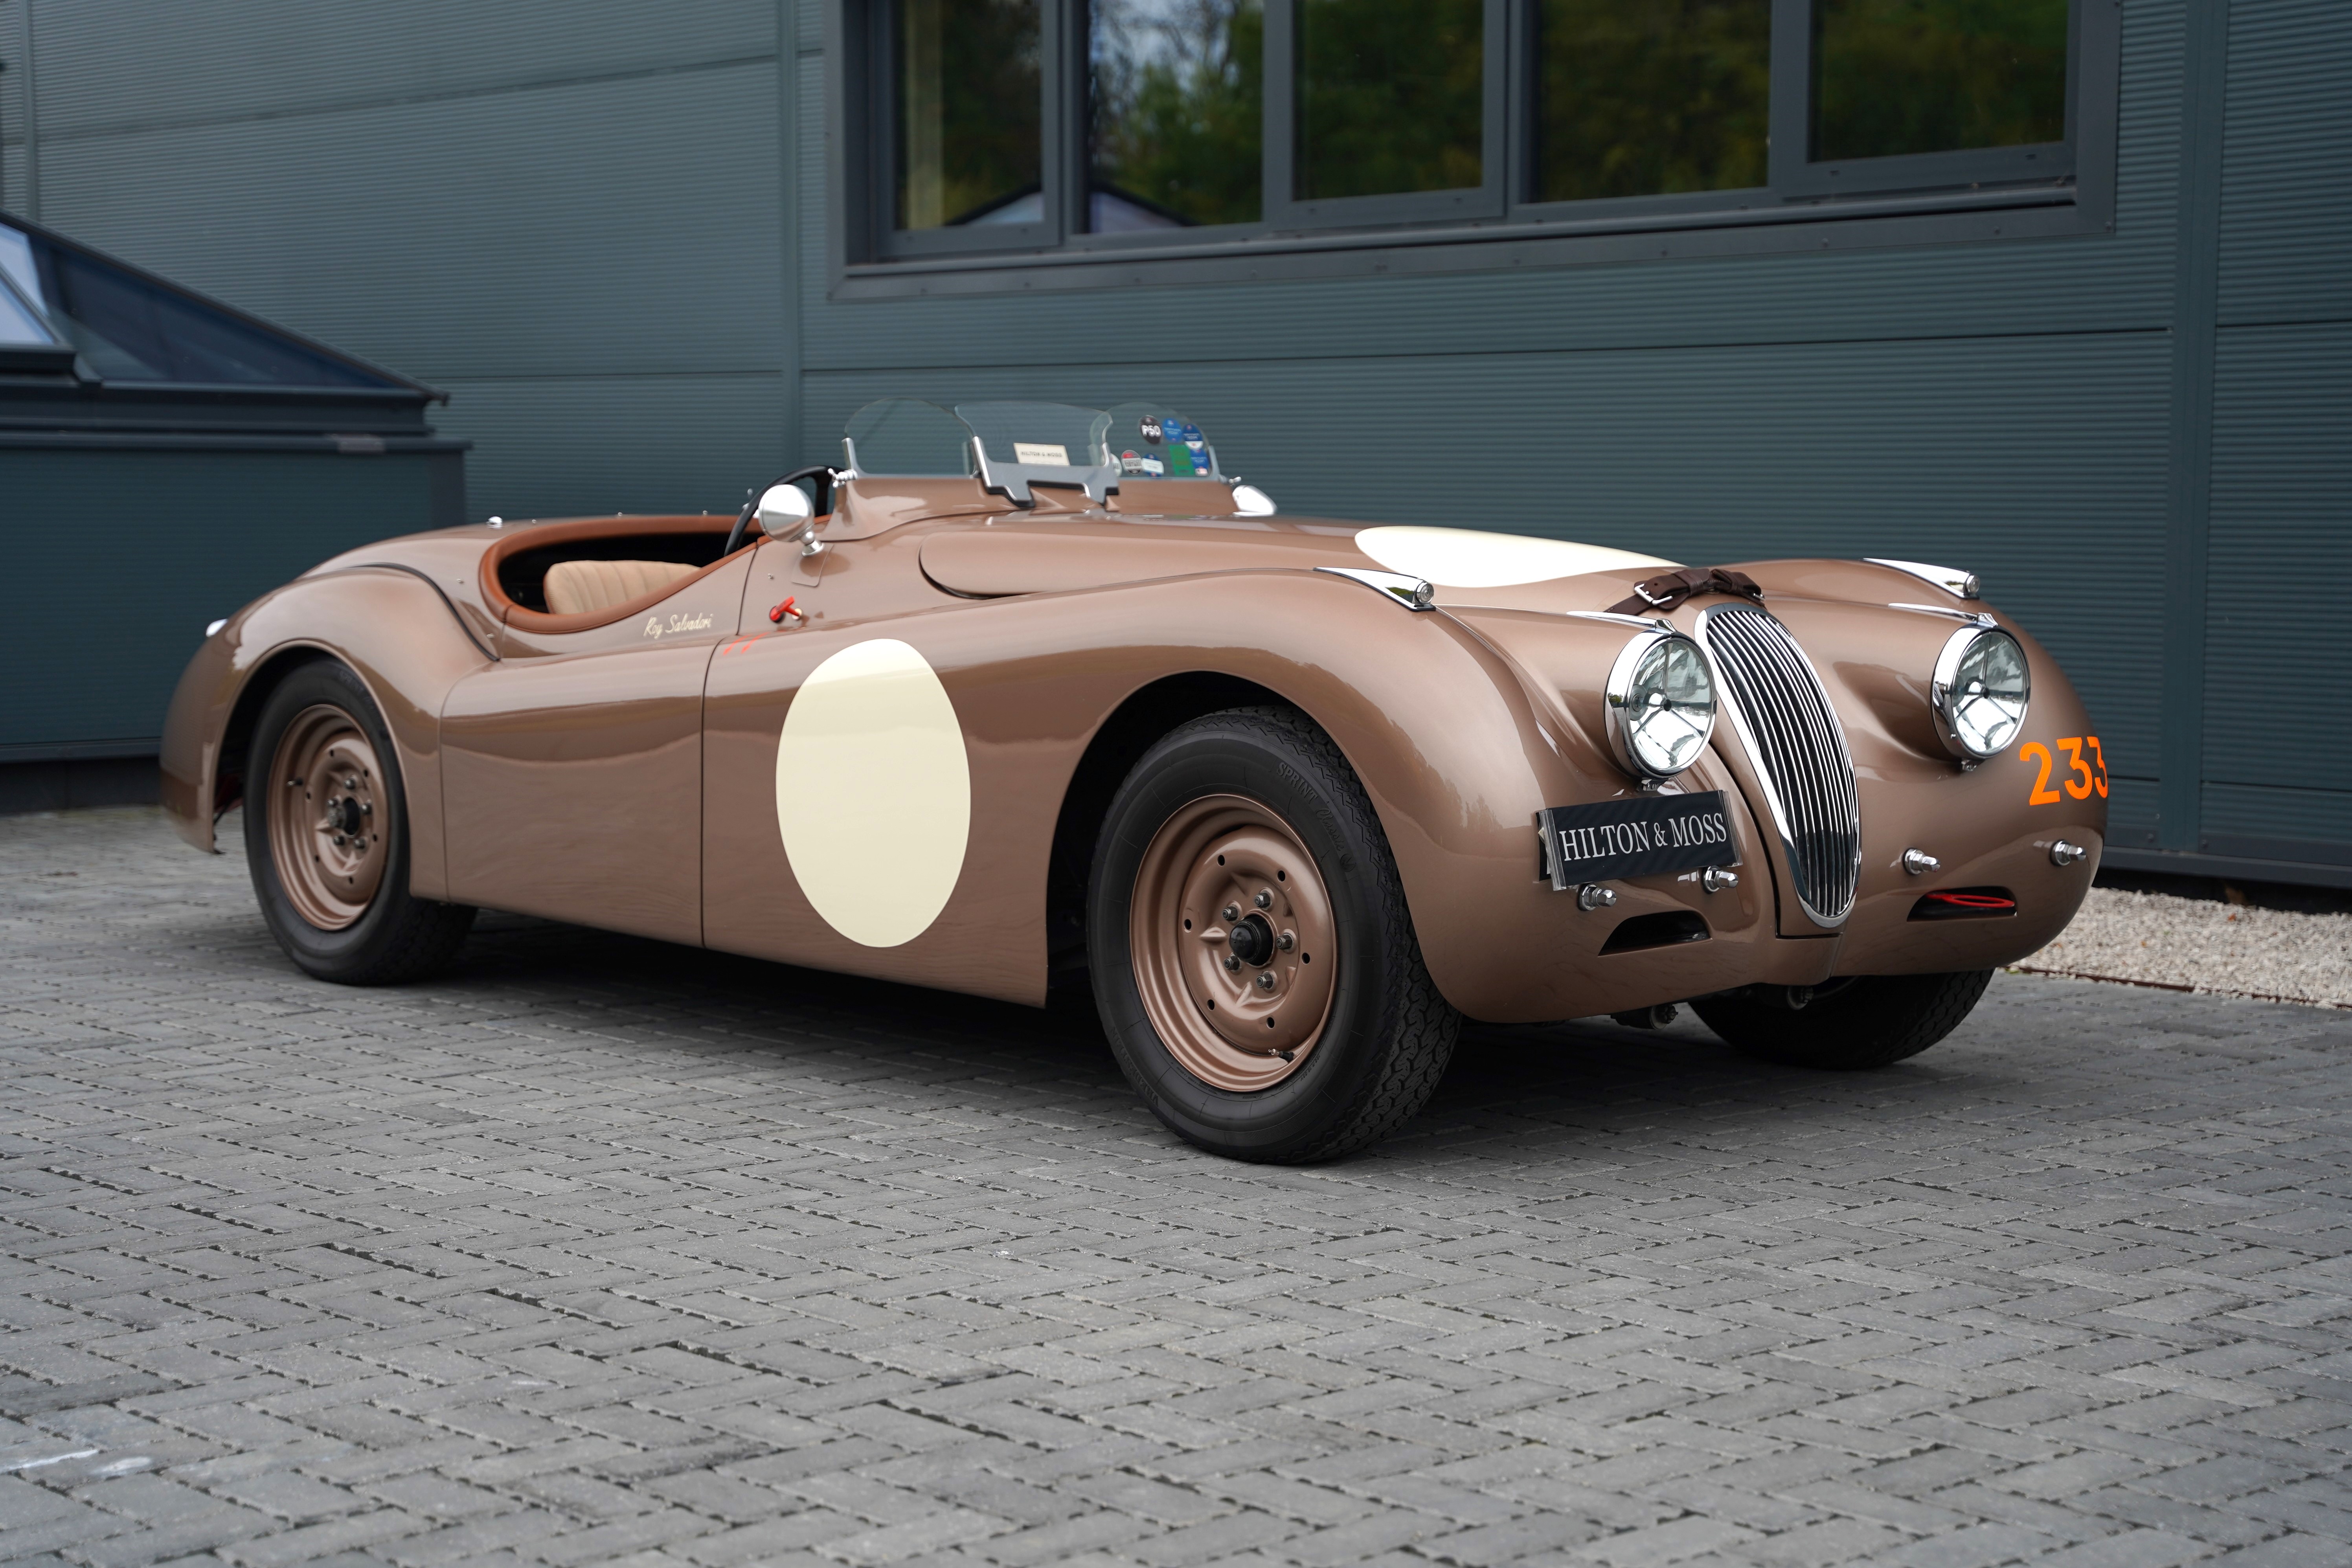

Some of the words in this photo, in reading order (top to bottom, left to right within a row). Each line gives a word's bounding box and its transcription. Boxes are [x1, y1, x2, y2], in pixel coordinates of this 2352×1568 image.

[643, 617, 663, 639] Roy
[665, 612, 714, 633] Salvadori
[2019, 736, 2108, 806] 233
[1277, 762, 1318, 804] SPRINT
[1316, 808, 1344, 851] Classic
[1559, 821, 1650, 861] HILTON
[1654, 822, 1668, 847] &
[1668, 813, 1727, 848] MOSS
